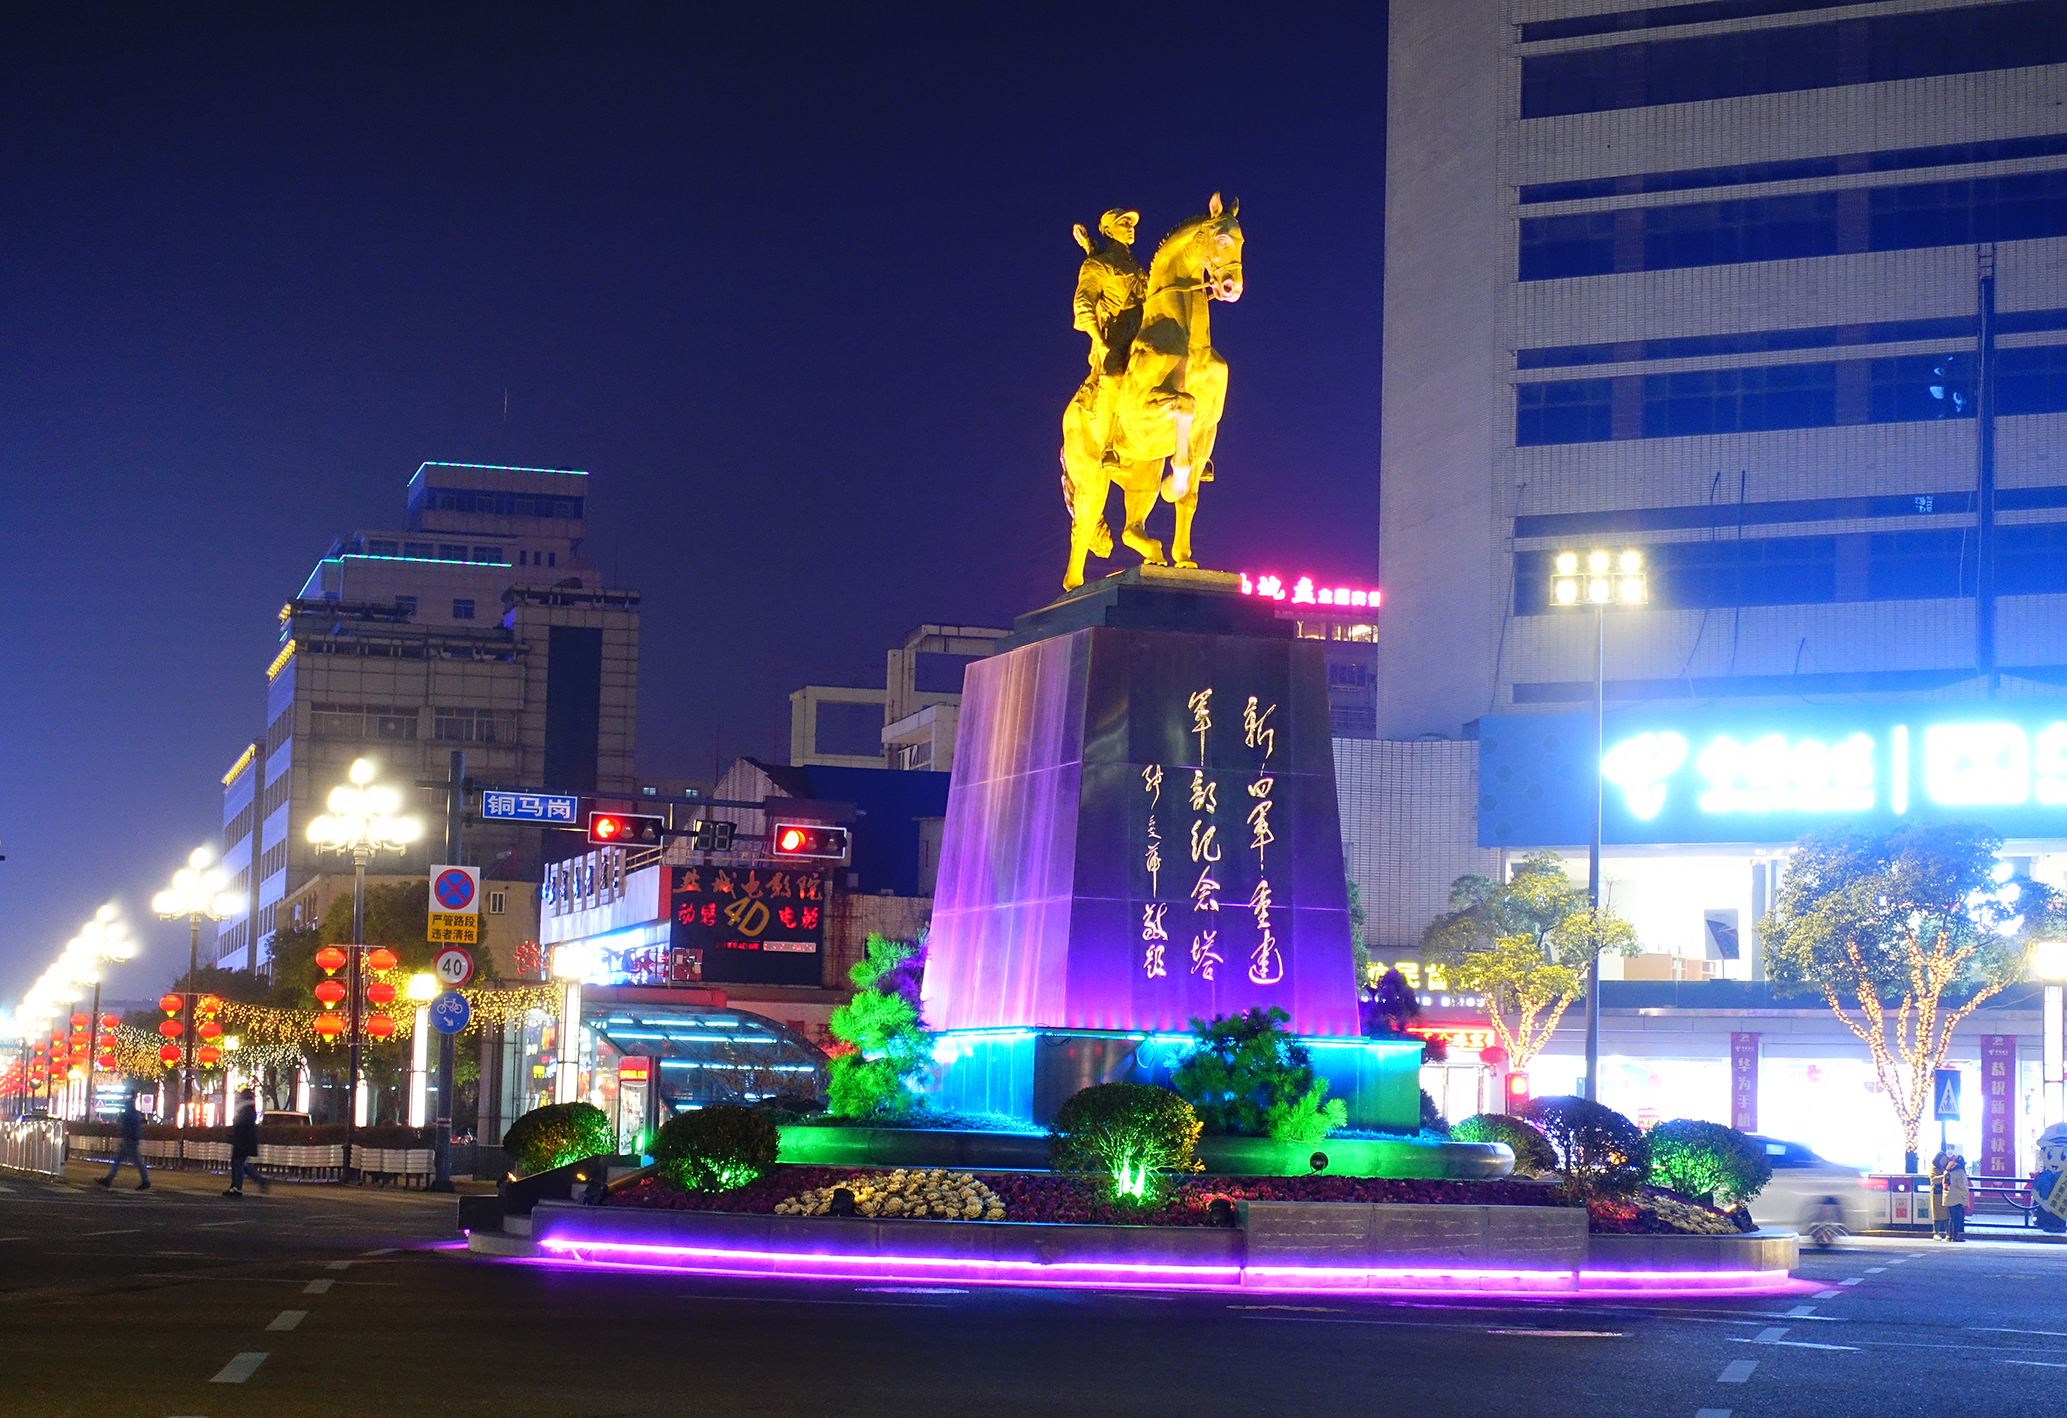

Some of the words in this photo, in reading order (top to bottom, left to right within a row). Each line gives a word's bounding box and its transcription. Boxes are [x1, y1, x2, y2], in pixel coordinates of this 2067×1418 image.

[487, 795, 571, 819] 铜马岗
[673, 868, 823, 900] 盐城电影院
[432, 914, 475, 928] 严管路段
[724, 897, 770, 937] 4D
[778, 906, 819, 930] 电影
[431, 928, 474, 941] 违者清拖
[442, 958, 462, 976] 40
[1737, 1057, 1752, 1127] 华为手机
[1990, 1061, 2006, 1171] 恭祝新春快乐
